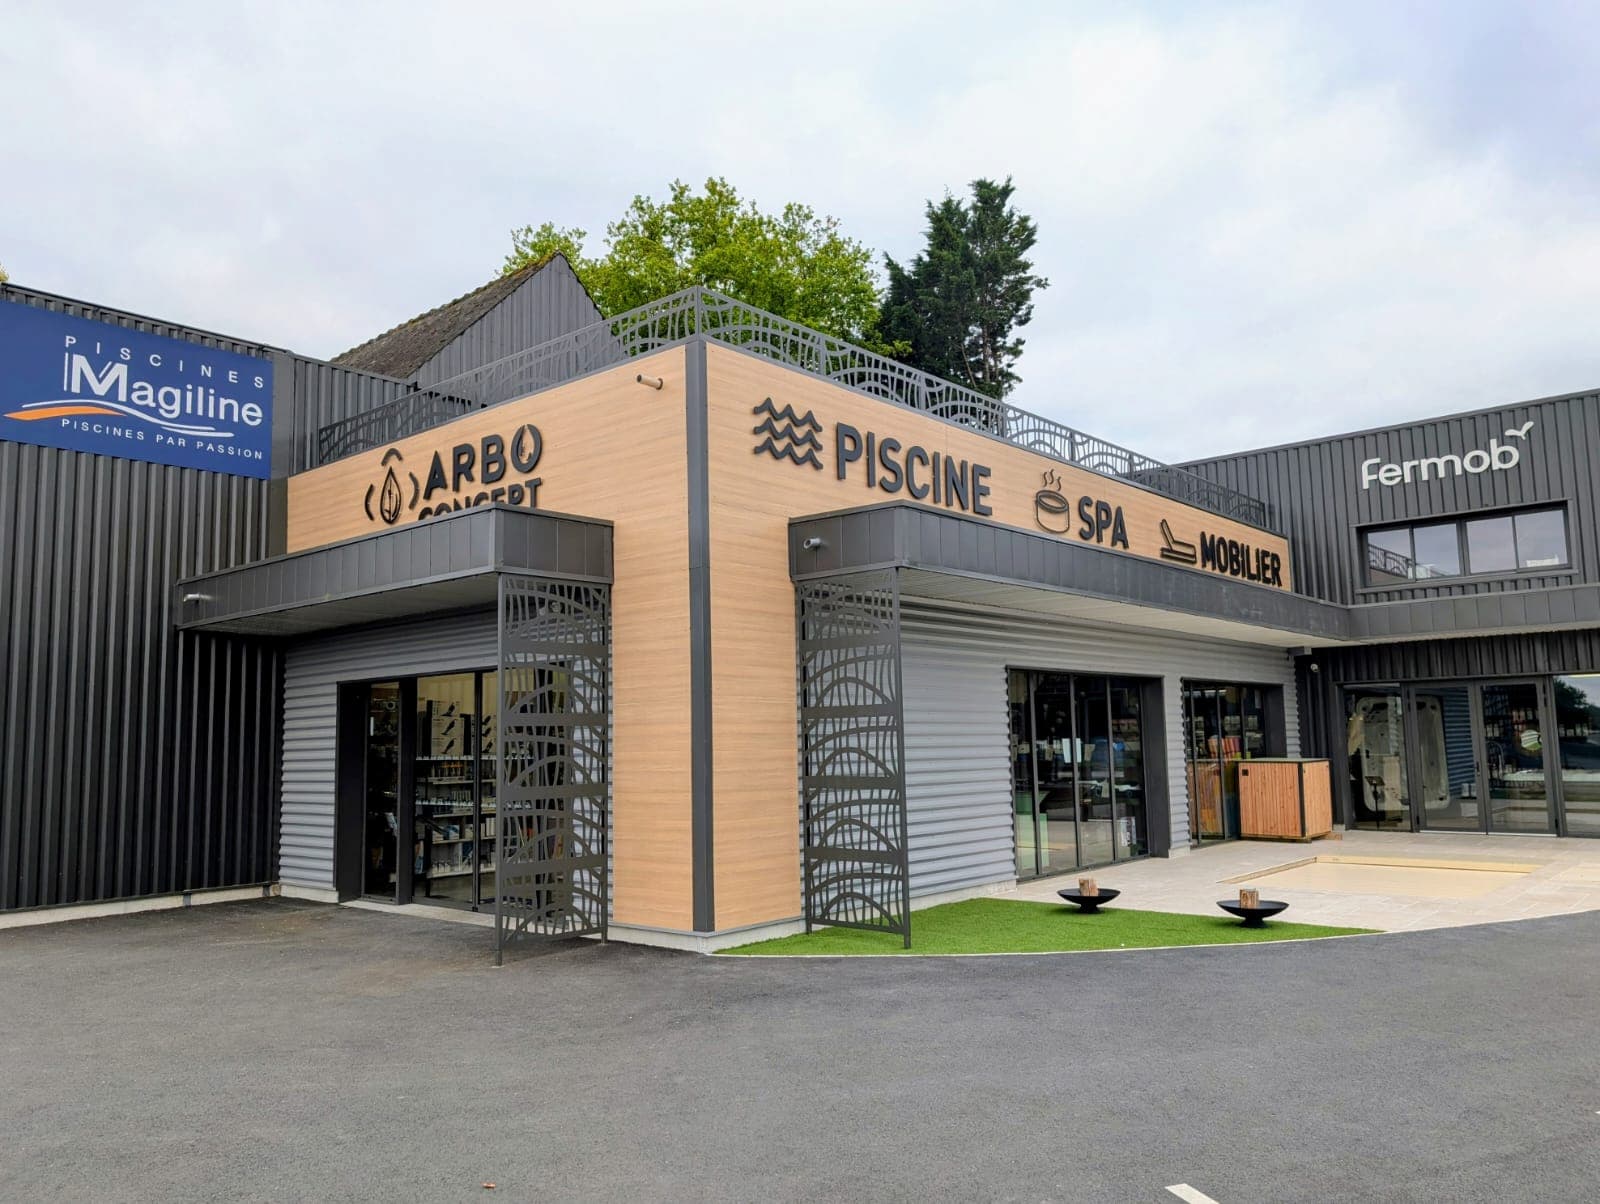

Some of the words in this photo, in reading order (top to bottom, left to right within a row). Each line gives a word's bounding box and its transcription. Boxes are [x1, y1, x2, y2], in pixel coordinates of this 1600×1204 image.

[63, 352, 263, 427] Magiline
[65, 335, 264, 389] PISCINES
[61, 418, 145, 441] PISCINES
[156, 434, 187, 448] PAR
[196, 441, 263, 460] PASSION
[422, 423, 543, 501] ARBO
[836, 421, 993, 516] PISCINE
[1077, 495, 1130, 549] SPA
[1199, 530, 1283, 588] MOBILIER
